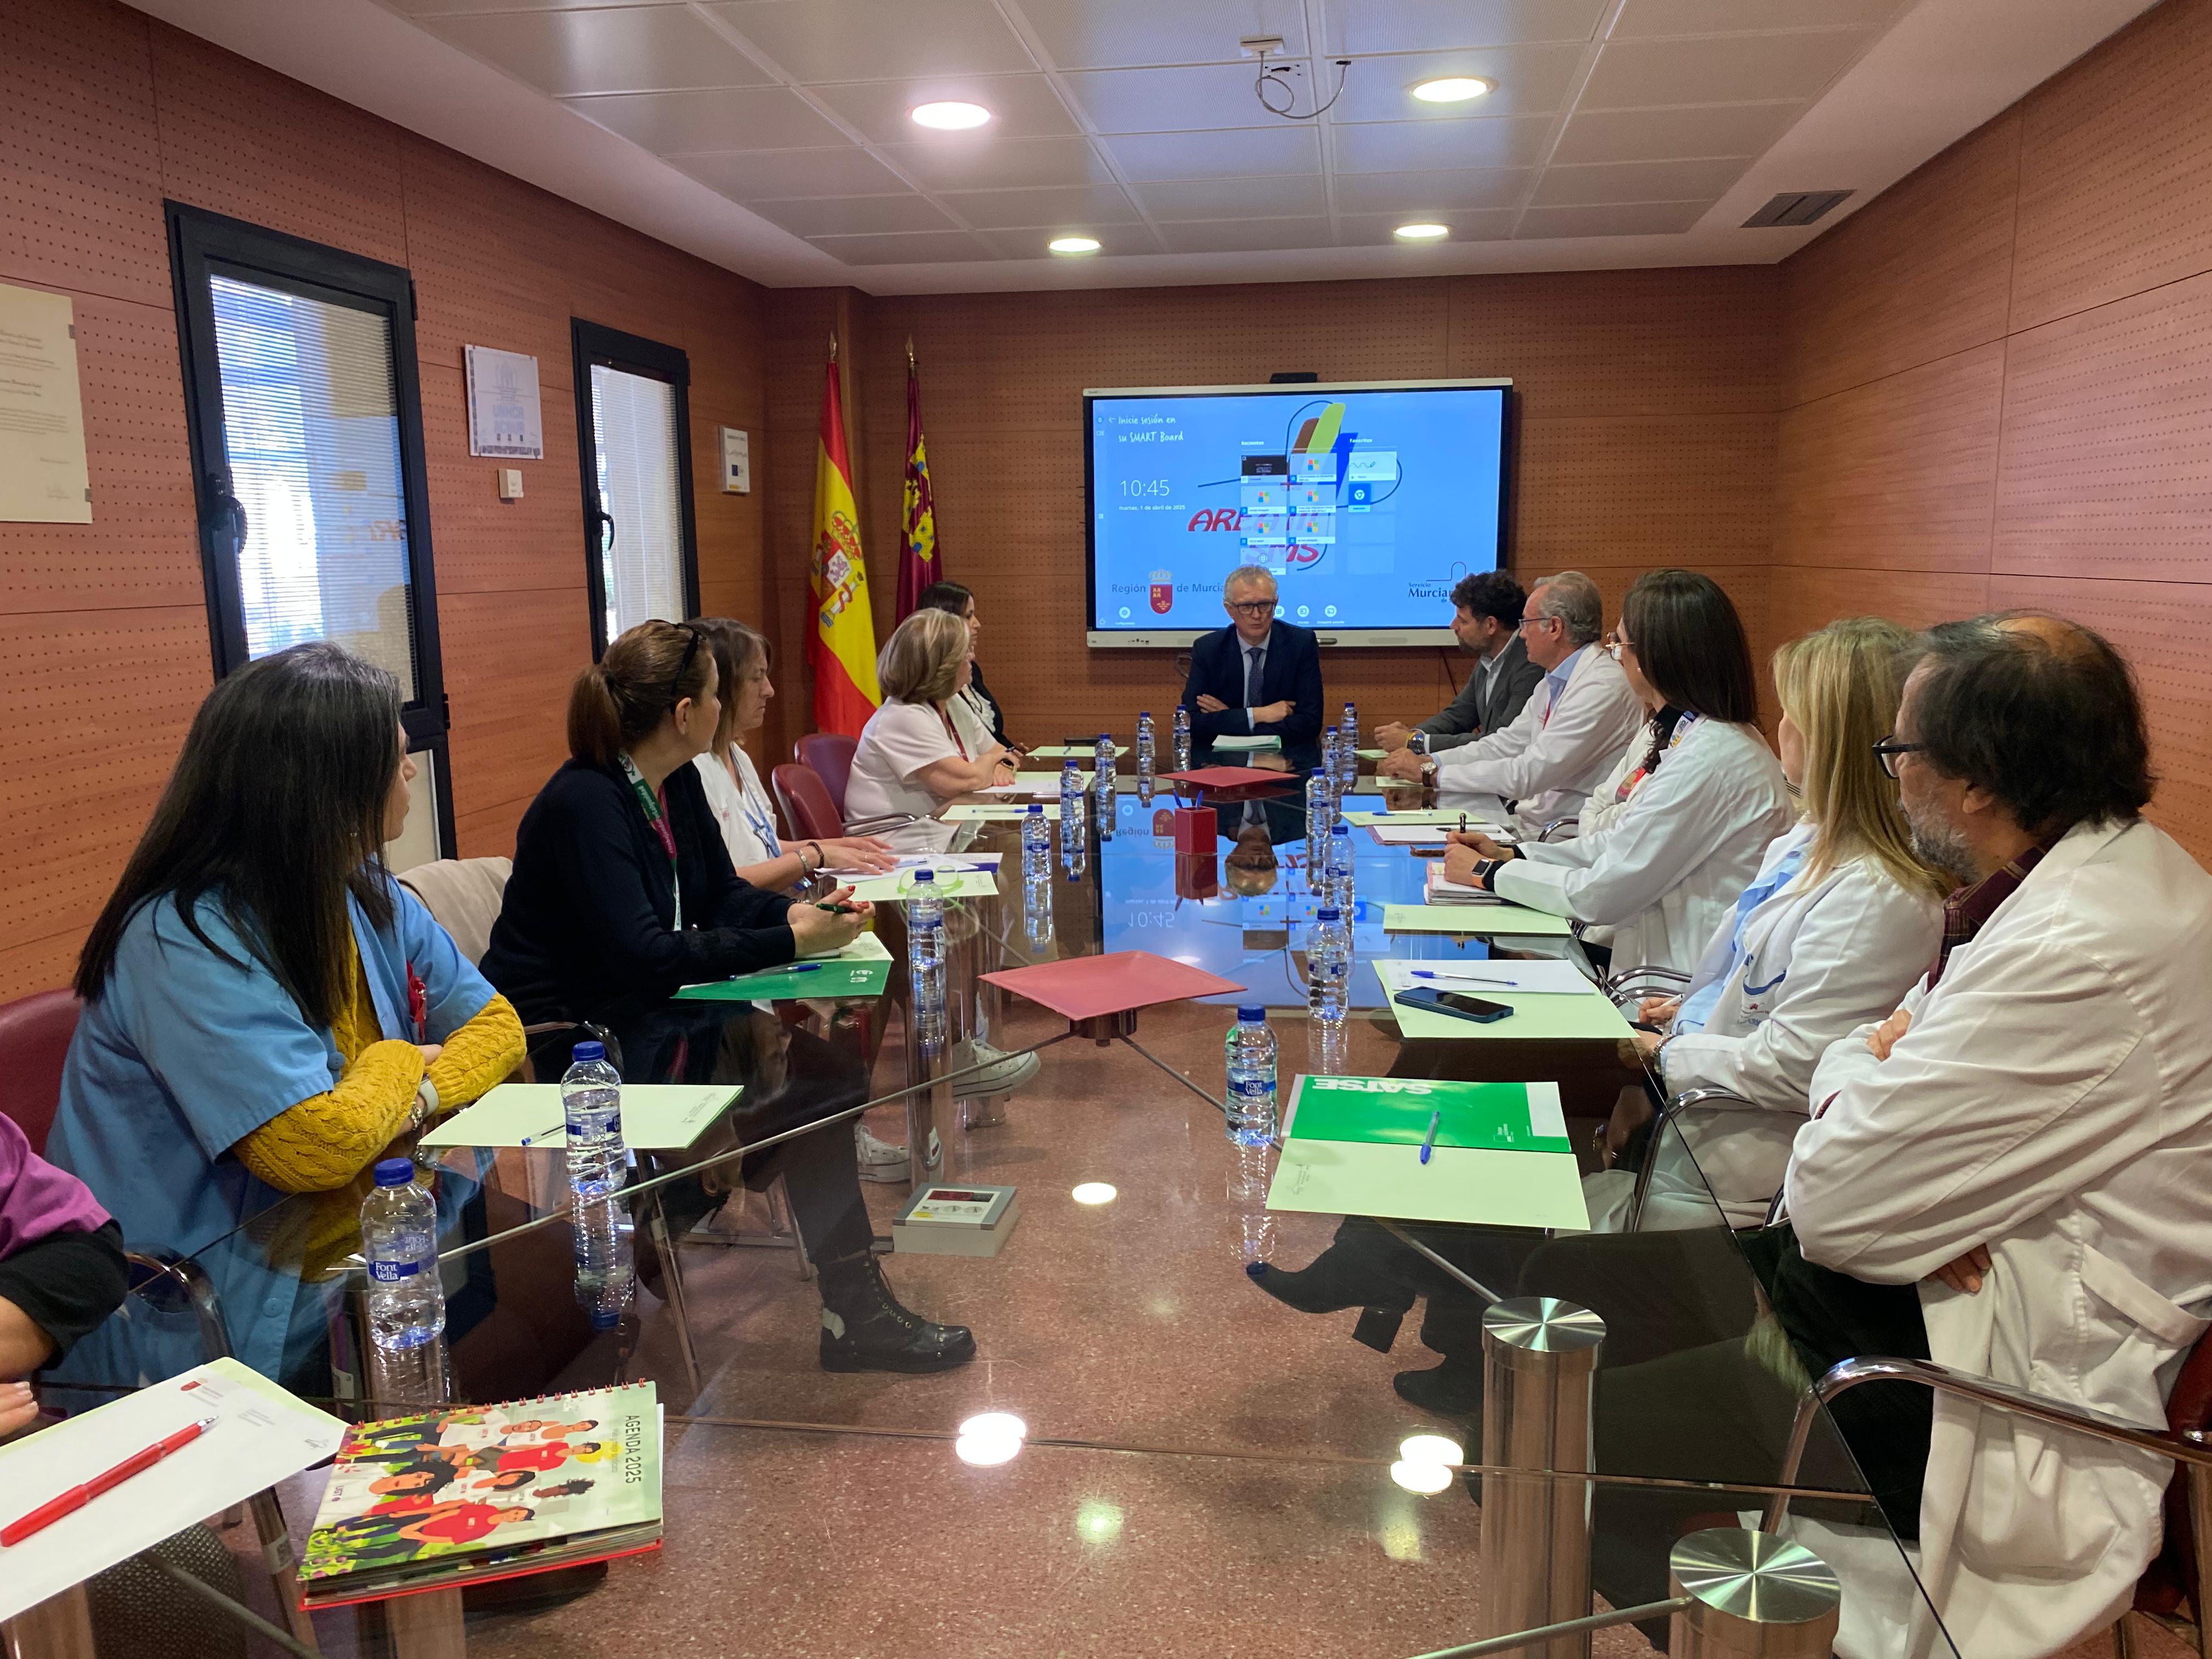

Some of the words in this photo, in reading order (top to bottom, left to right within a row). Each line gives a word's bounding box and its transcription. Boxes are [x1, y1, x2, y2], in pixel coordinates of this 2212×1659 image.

[1118, 415, 1138, 425] Inicie
[1141, 414, 1164, 425] sesión
[1119, 435, 1127, 443] su
[1130, 431, 1157, 443] SMART
[1160, 431, 1184, 443] Board
[1120, 479, 1170, 496] 10:45
[1112, 583, 1146, 594] Región
[1177, 583, 1189, 592] de
[1408, 587, 1453, 597] Murcia
[1312, 1078, 1432, 1094] SATSE
[375, 1262, 398, 1272] Font
[376, 1271, 399, 1280] Vella
[625, 1415, 641, 1454] AGENDA
[625, 1456, 641, 1483] 2025
